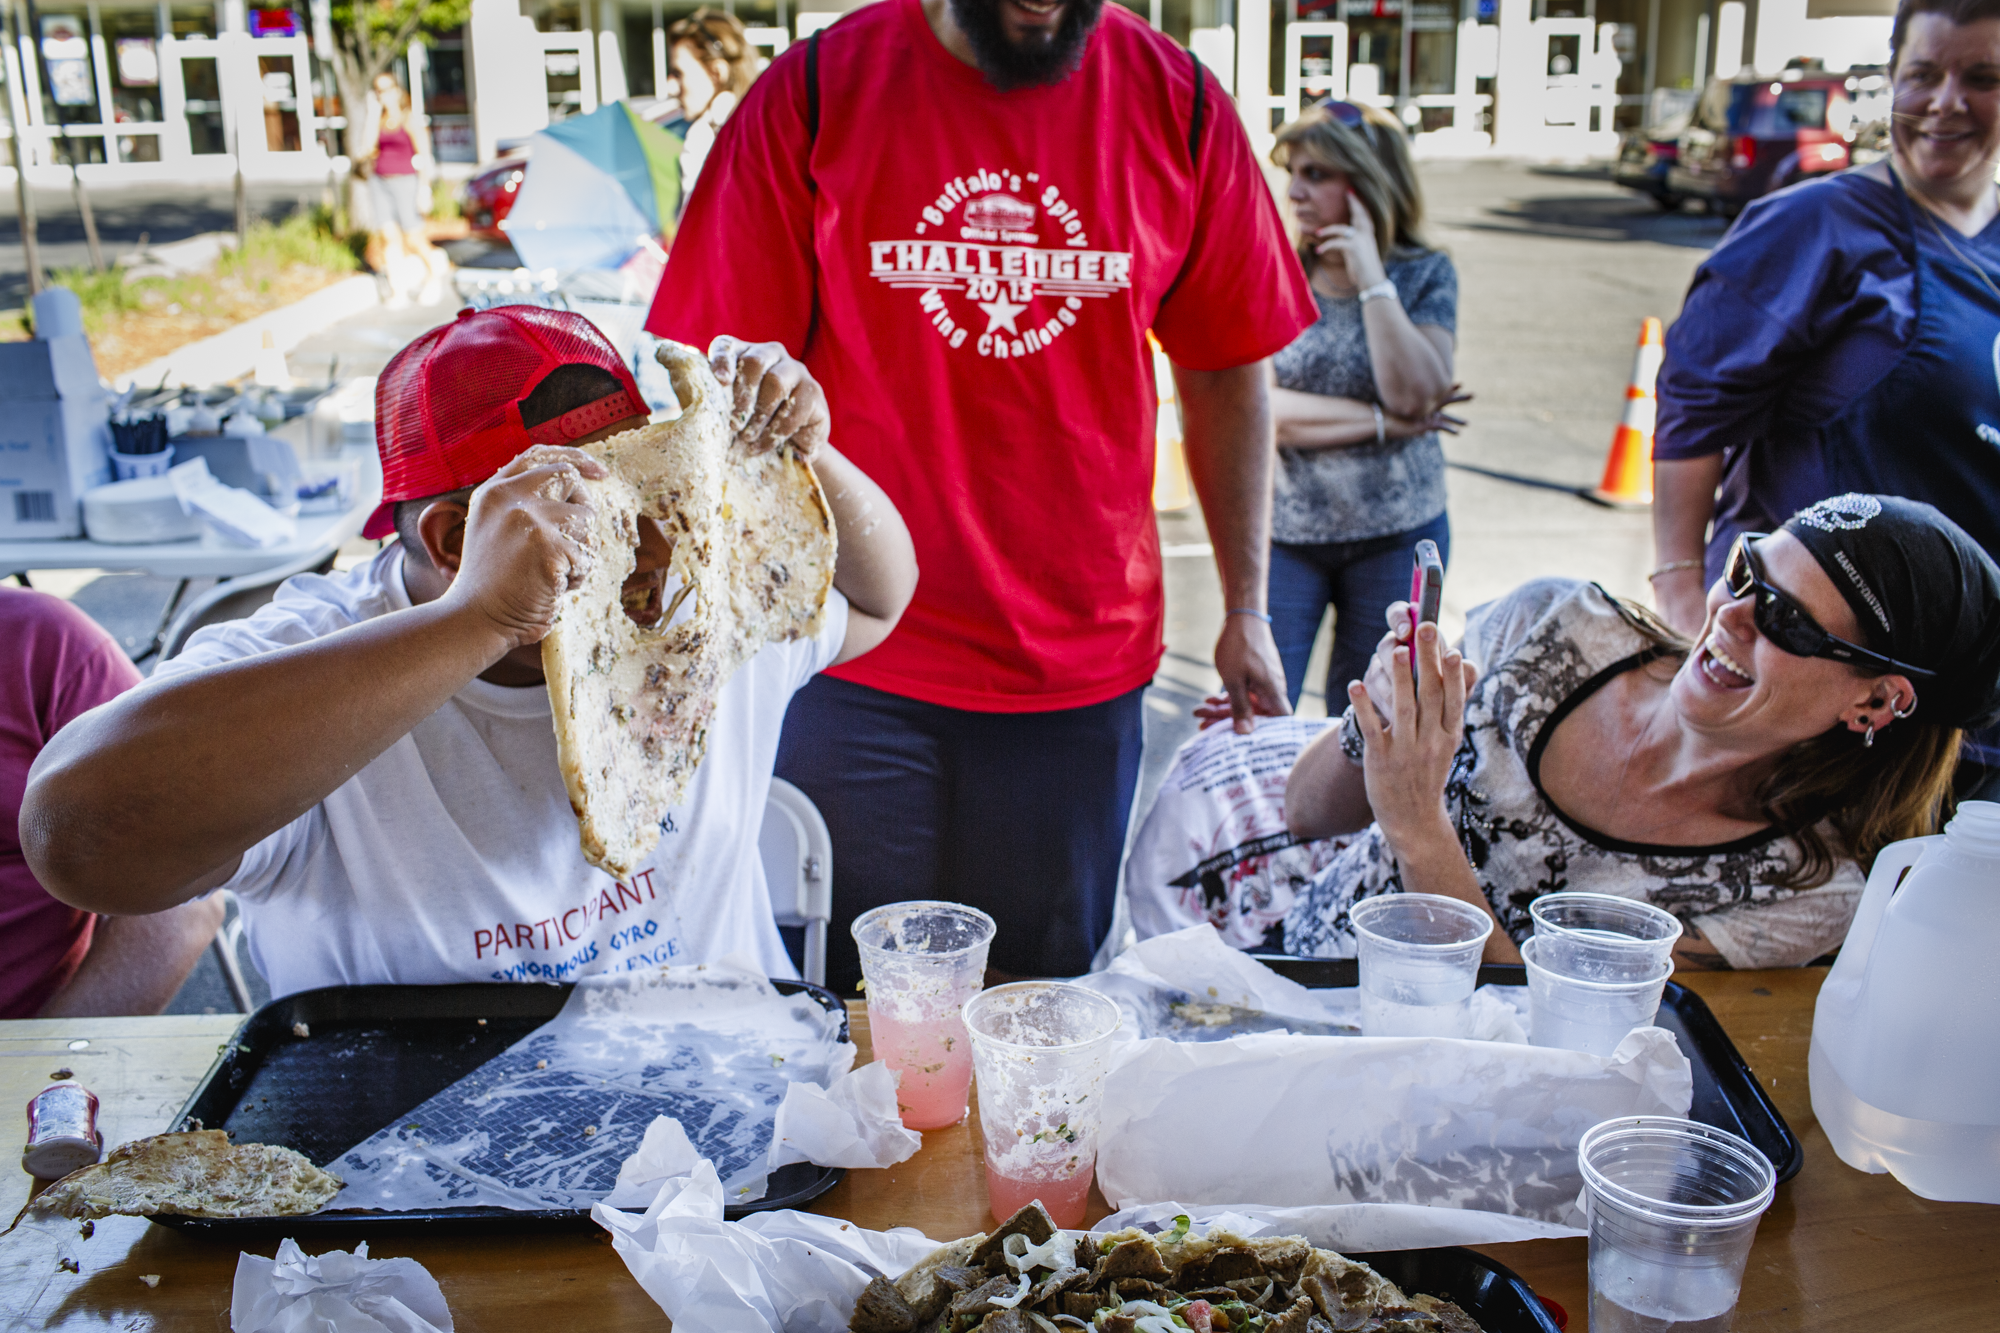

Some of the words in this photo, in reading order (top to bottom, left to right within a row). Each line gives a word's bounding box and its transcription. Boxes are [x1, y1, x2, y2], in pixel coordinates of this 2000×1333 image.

[870, 244, 1130, 282] CHALLENGER
[965, 278, 1033, 302] 2013
[919, 288, 968, 349] Wing
[977, 296, 1083, 359] Challenge
[474, 867, 657, 959] PARTICIPANT
[610, 918, 659, 951] GYRO
